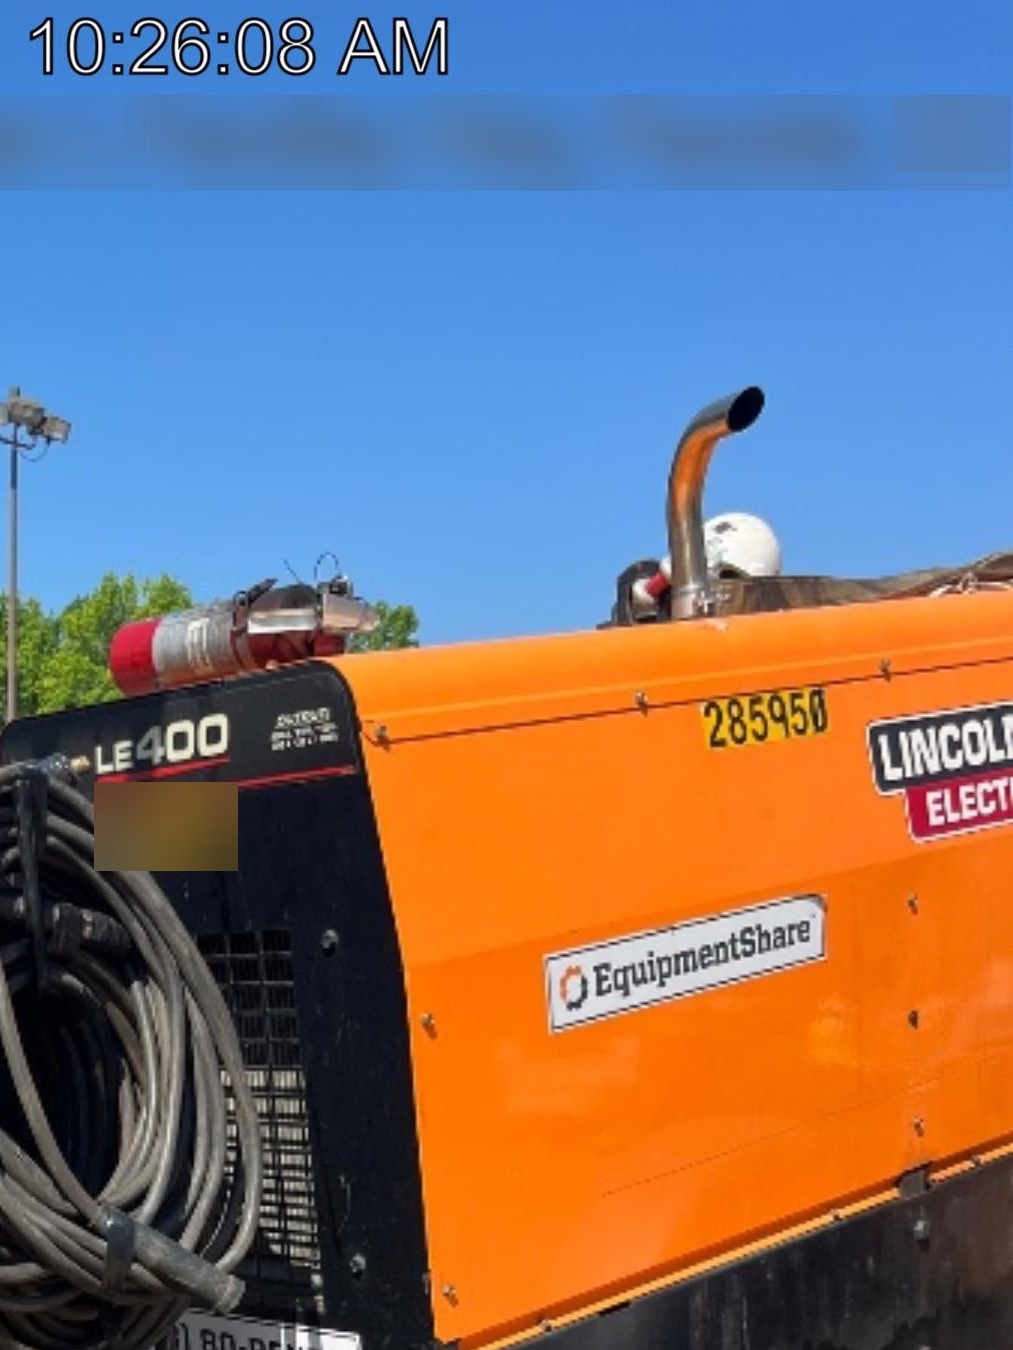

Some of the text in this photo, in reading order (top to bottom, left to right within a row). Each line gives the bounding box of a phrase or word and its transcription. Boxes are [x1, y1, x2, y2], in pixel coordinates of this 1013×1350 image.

[703, 689, 828, 747] 285950
[925, 776, 1013, 826] ELECT
[593, 919, 811, 997] EquipmentShare
